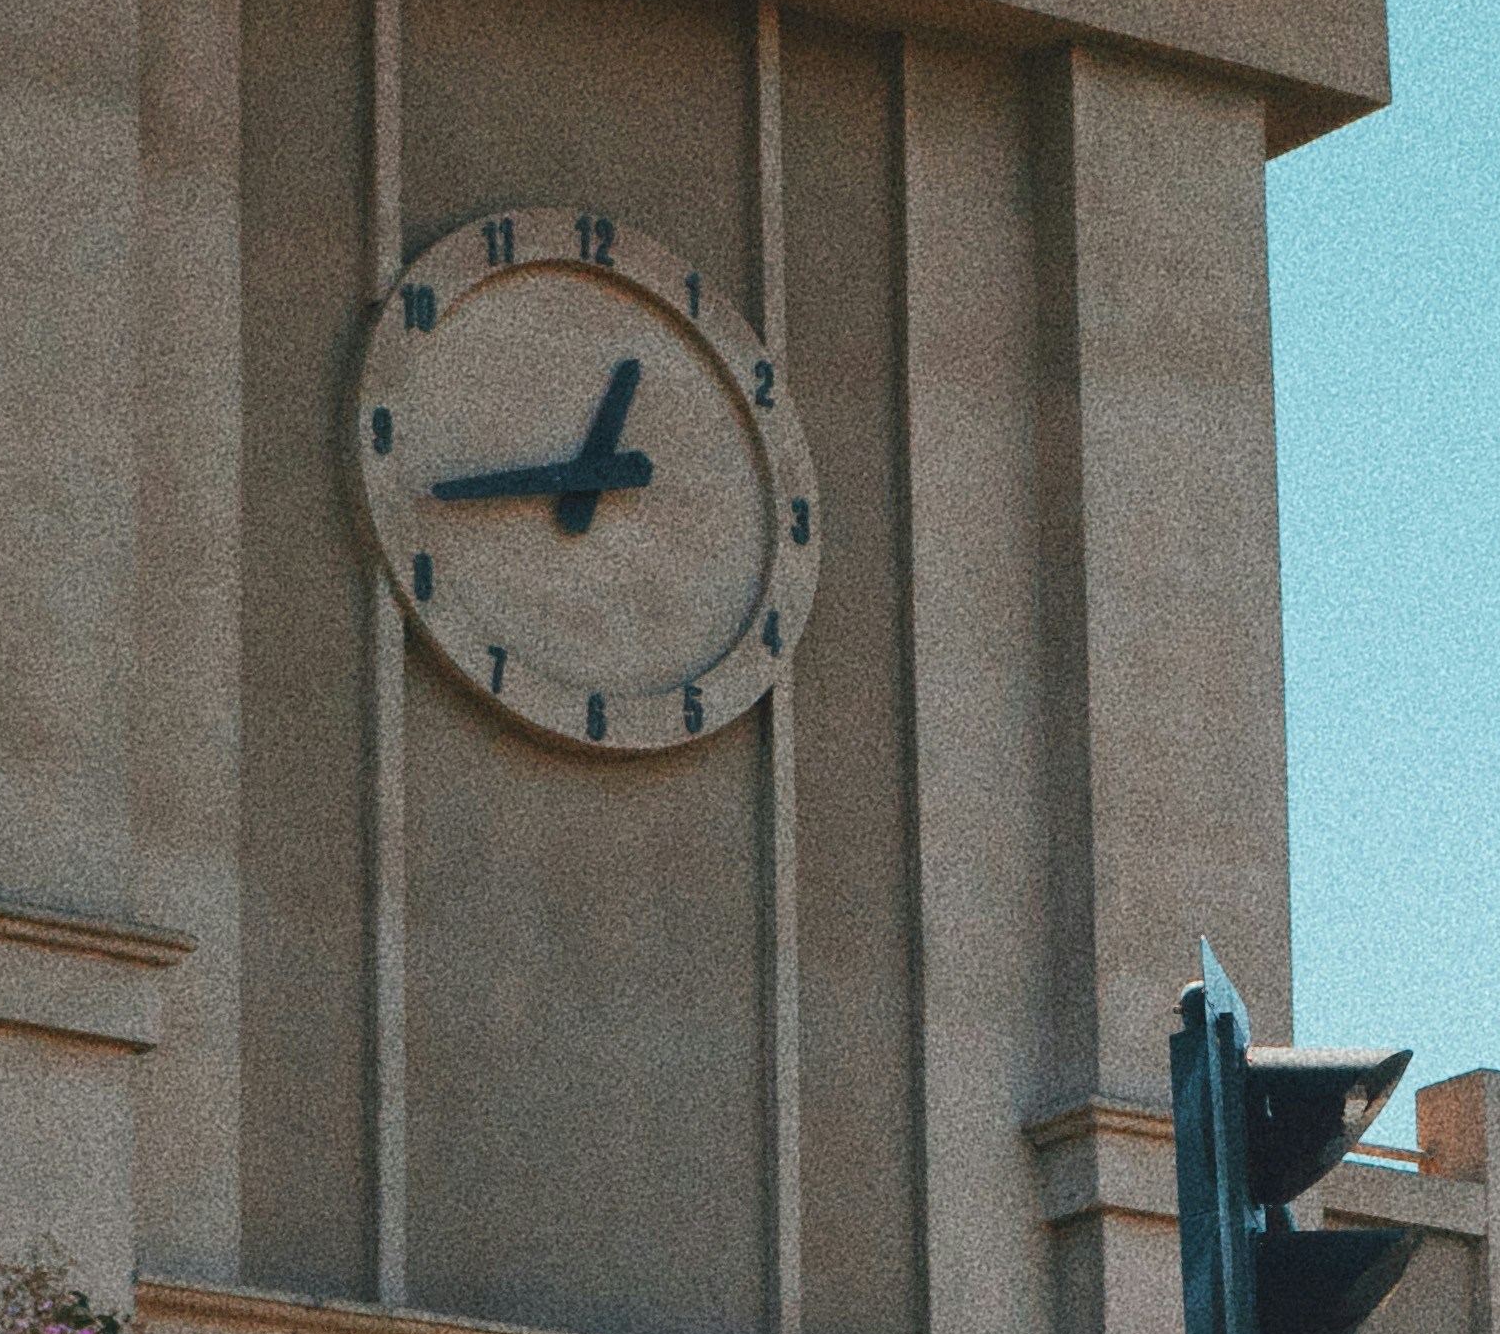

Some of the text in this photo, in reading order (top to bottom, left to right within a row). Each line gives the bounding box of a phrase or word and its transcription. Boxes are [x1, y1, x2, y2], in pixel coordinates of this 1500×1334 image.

[482, 218, 514, 266] 11
[576, 215, 614, 267] 12
[400, 283, 436, 334] 10
[686, 272, 700, 318] 1
[754, 360, 774, 409] 2
[791, 498, 809, 545] 3
[763, 610, 782, 657] 4
[487, 645, 508, 694] 7
[586, 692, 606, 741] 6
[684, 685, 704, 734] 5
